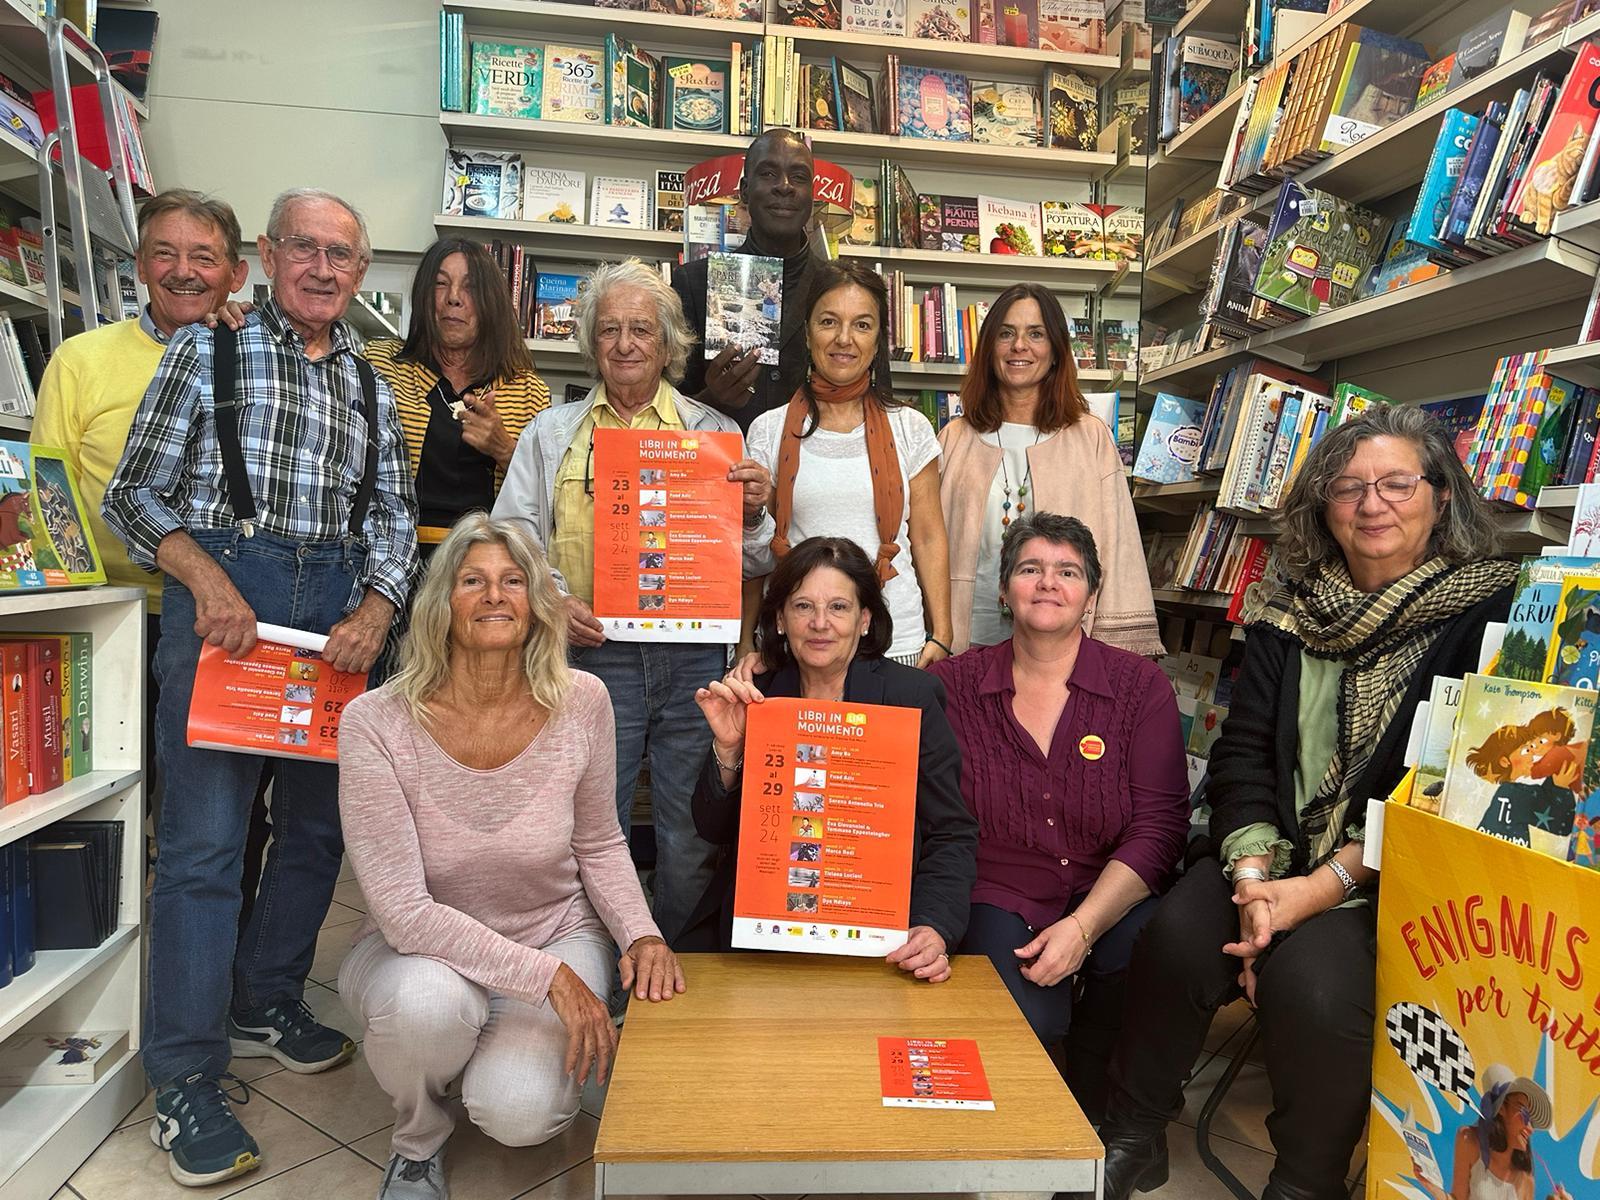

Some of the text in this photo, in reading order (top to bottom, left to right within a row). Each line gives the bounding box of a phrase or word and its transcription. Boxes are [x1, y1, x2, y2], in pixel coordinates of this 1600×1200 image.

[854, 5, 880, 16] BENE
[492, 57, 523, 68] Ricette
[563, 62, 594, 78] 365
[480, 69, 535, 87] VERDI
[680, 74, 720, 86] Pasta
[530, 169, 568, 180] CUCINA
[945, 209, 978, 219] PIANTE
[987, 204, 1027, 218] Ikebana
[1046, 214, 1100, 227] POTATURA
[540, 277, 567, 285] Cucina
[540, 284, 576, 293] Marinara
[640, 440, 663, 449] LIBRI
[667, 440, 678, 448] IN
[640, 450, 697, 460] MOVIMENTO
[612, 480, 630, 491] 23
[612, 504, 630, 515] 29
[612, 530, 629, 542] 20
[612, 544, 628, 555] 24
[77, 649, 89, 717] Darwin
[329, 674, 349, 686] 20
[1483, 683, 1542, 704] Kate Thompson
[323, 700, 344, 713] 29
[798, 711, 826, 722] LIBRI
[830, 712, 842, 723] IN
[44, 705, 53, 749] Musil
[320, 725, 338, 738] 23
[797, 722, 864, 737] MOVIMENTO
[10, 709, 19, 760] Vasari
[764, 754, 785, 767] 23
[763, 783, 783, 796] 29
[1498, 797, 1512, 824] Ti
[760, 814, 780, 828] 20
[760, 830, 778, 843] 24
[1401, 895, 1600, 1016] ENIGMIS
[1456, 975, 1510, 1028] per
